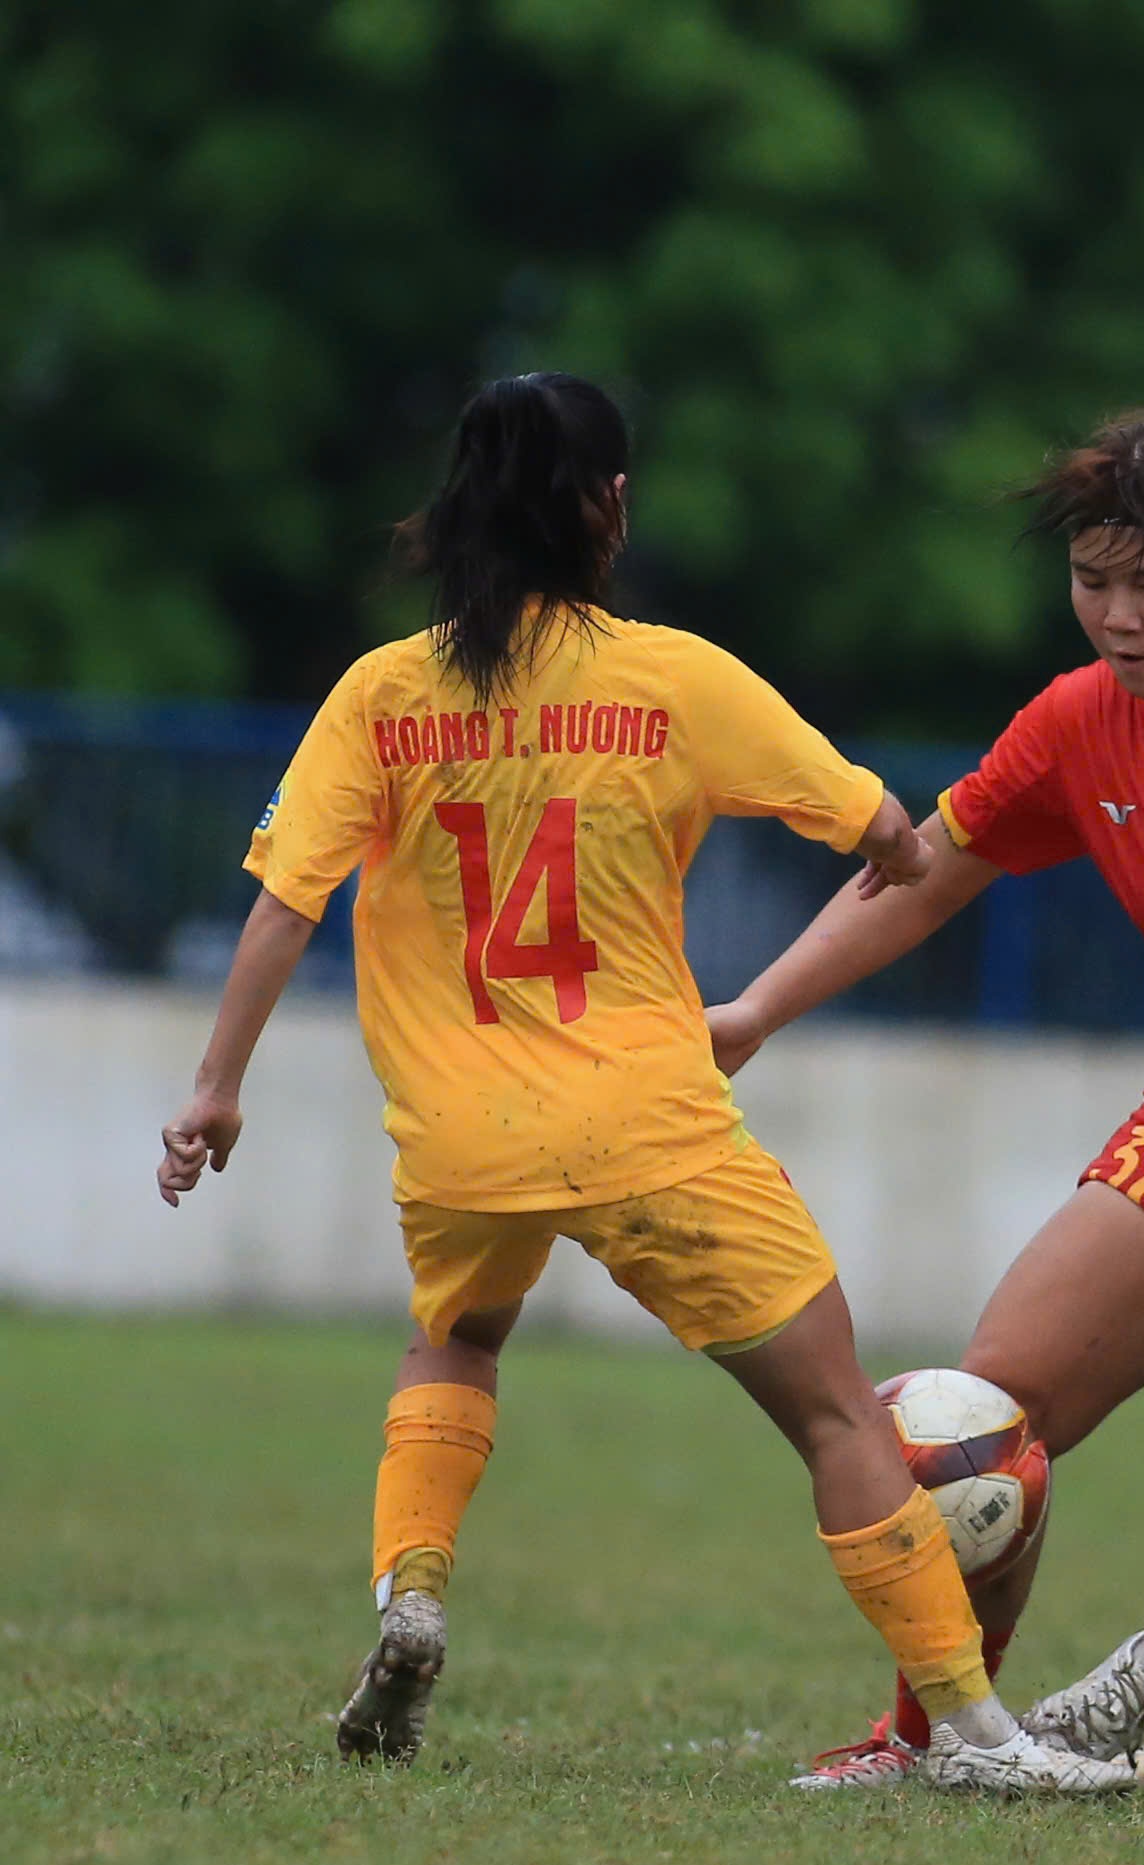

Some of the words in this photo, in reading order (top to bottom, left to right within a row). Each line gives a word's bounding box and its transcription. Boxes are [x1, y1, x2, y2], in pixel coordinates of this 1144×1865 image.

[499, 707, 530, 759] T.
[540, 700, 670, 759] NƯƠNG
[433, 798, 599, 1025] 14
